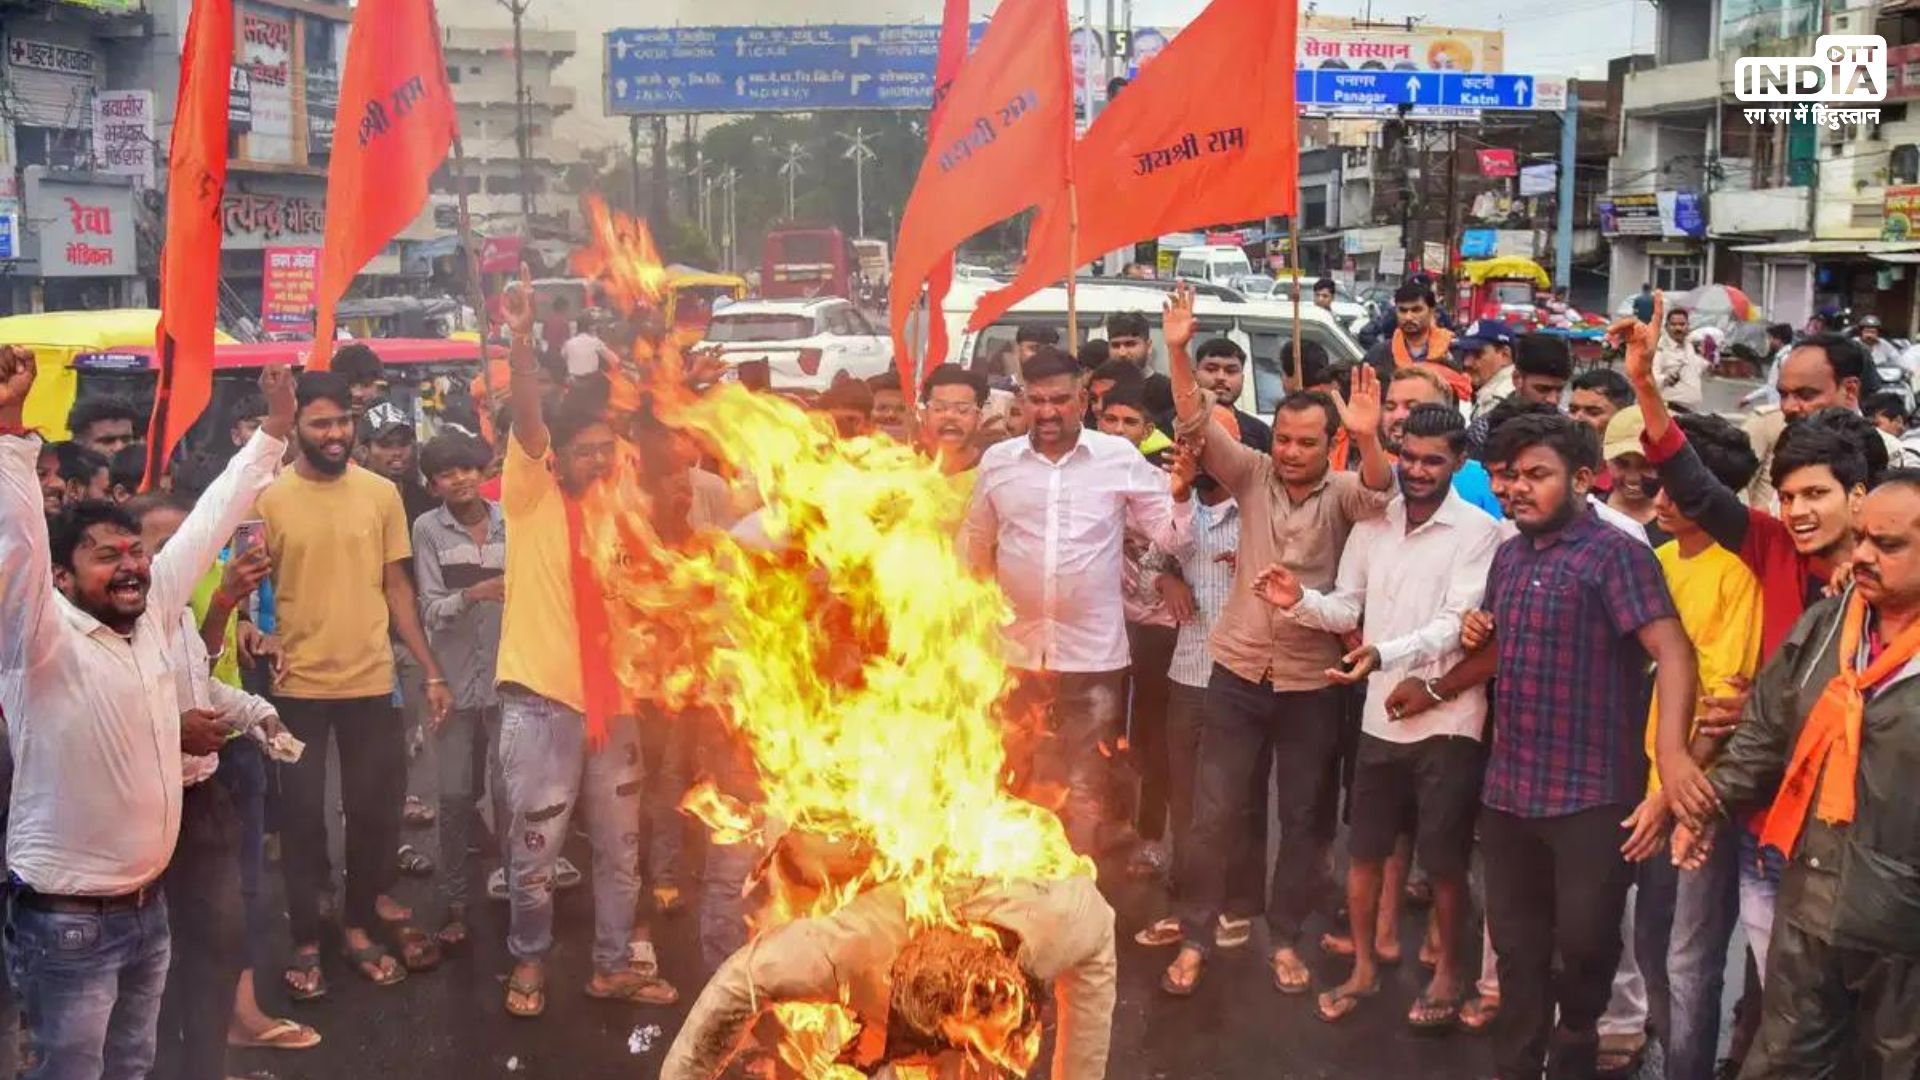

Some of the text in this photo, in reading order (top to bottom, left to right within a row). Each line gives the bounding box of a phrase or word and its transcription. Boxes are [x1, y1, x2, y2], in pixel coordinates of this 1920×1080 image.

[1305, 36, 1409, 58] सेवा संस्थान
[1335, 75, 1377, 88] पनागर
[1461, 76, 1495, 90] कटनी
[1333, 90, 1387, 105] Panagar
[1460, 93, 1499, 105] Katni
[1133, 127, 1244, 176] जयश्री राम
[64, 197, 112, 235] रेवा
